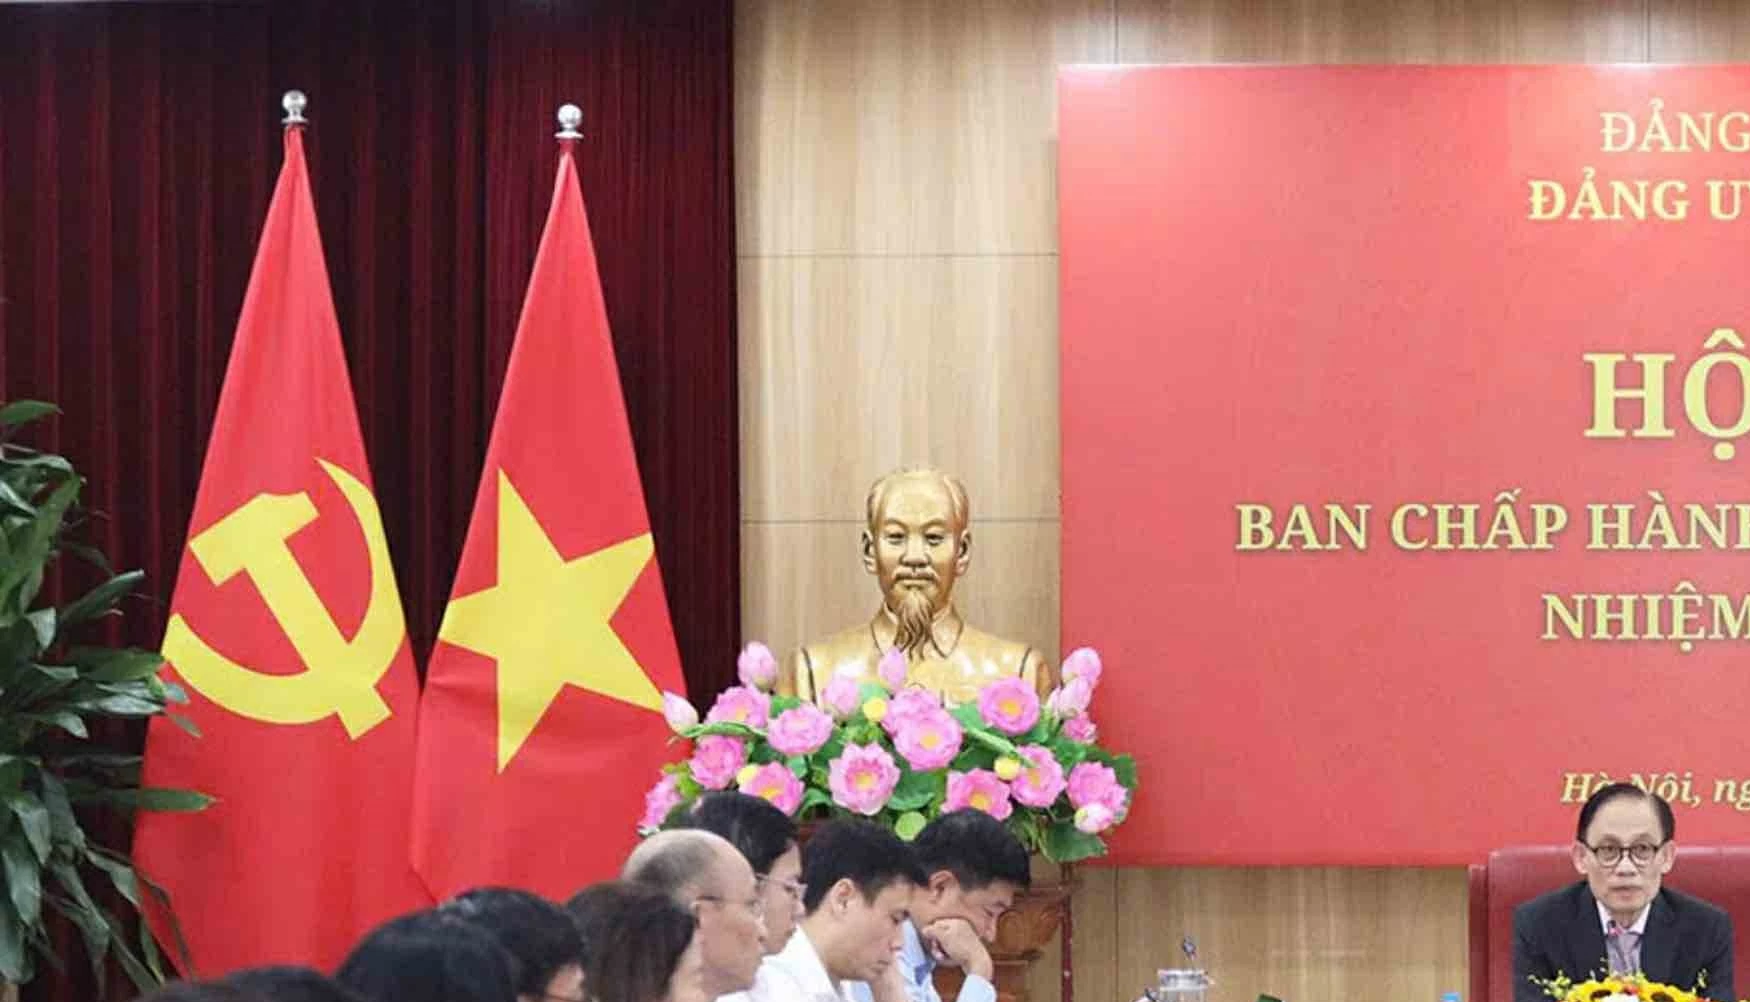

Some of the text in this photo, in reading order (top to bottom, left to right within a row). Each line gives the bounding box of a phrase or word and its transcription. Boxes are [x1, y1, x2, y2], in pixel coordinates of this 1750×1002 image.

[1528, 167, 1691, 223] ĐẢNG
[1236, 502, 1368, 552] BAN
[1389, 491, 1568, 552] CHẤP
